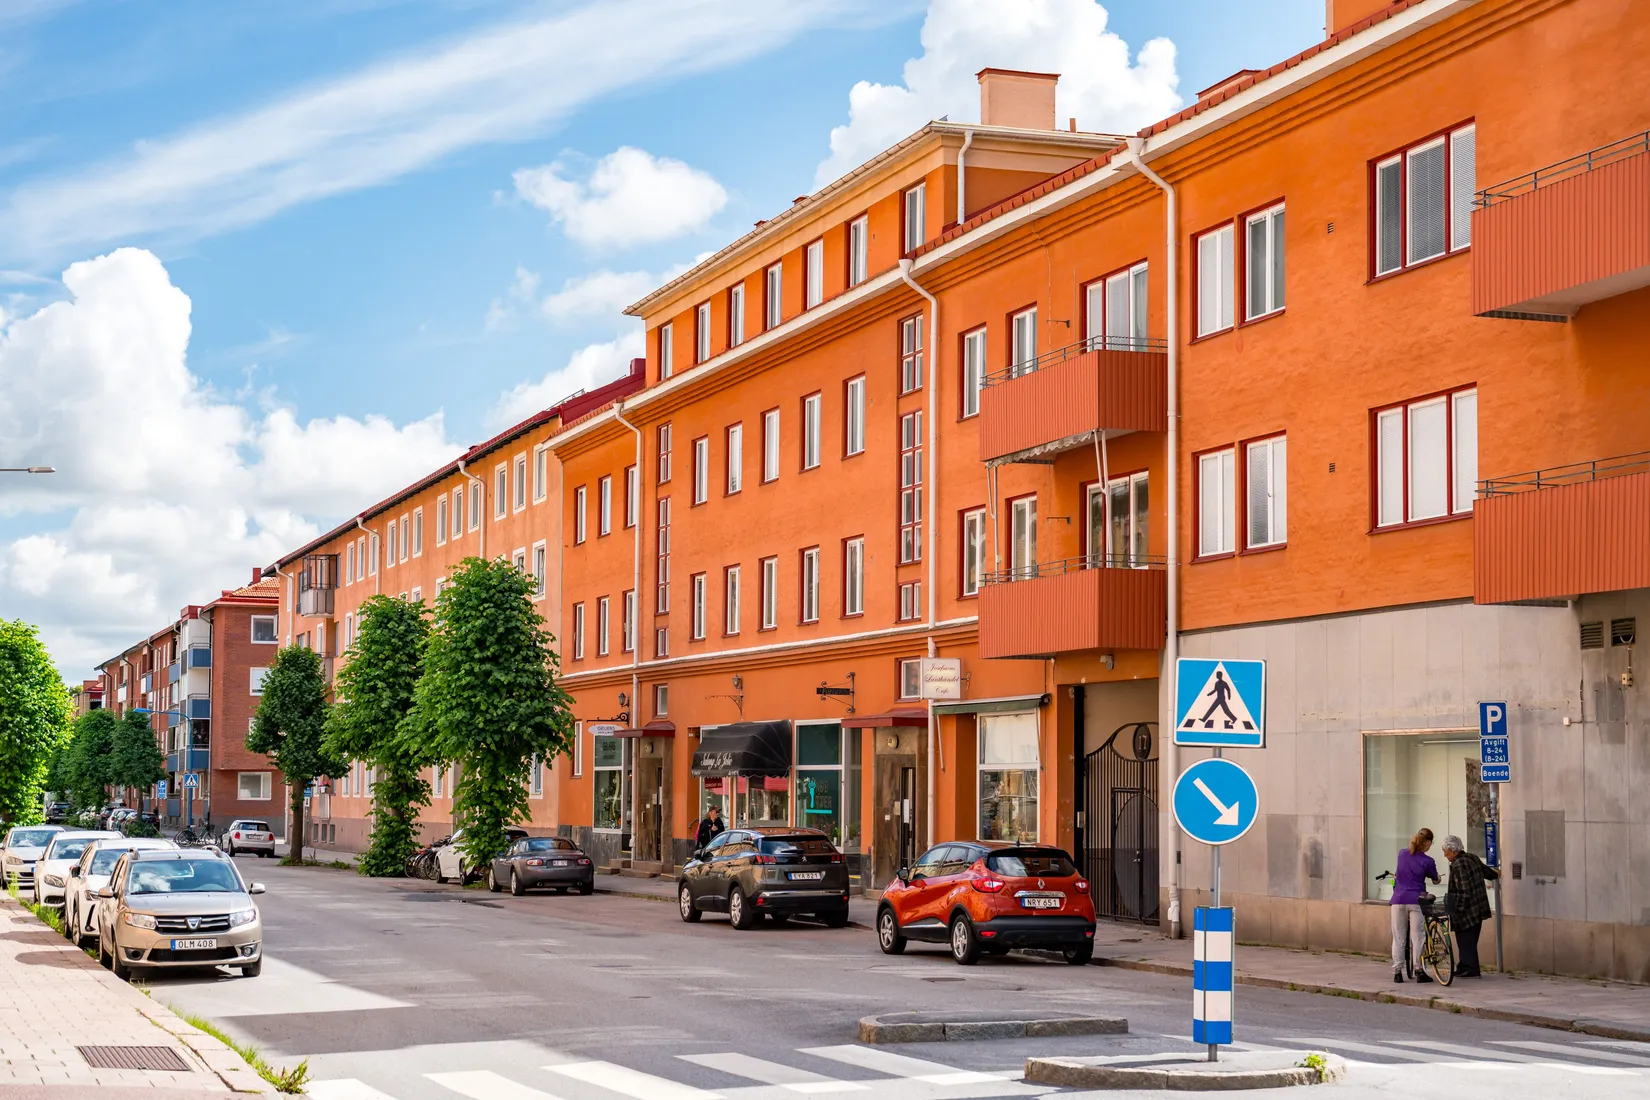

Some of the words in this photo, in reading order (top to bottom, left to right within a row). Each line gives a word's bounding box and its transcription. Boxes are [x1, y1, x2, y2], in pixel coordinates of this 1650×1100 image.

[1486, 705, 1503, 733] P
[1138, 735, 1147, 750] 17
[1484, 739, 1505, 747] Avgift
[1027, 898, 1041, 907] NRY
[1042, 898, 1057, 907] 651
[178, 940, 195, 949] OLM
[196, 940, 214, 948] 408
